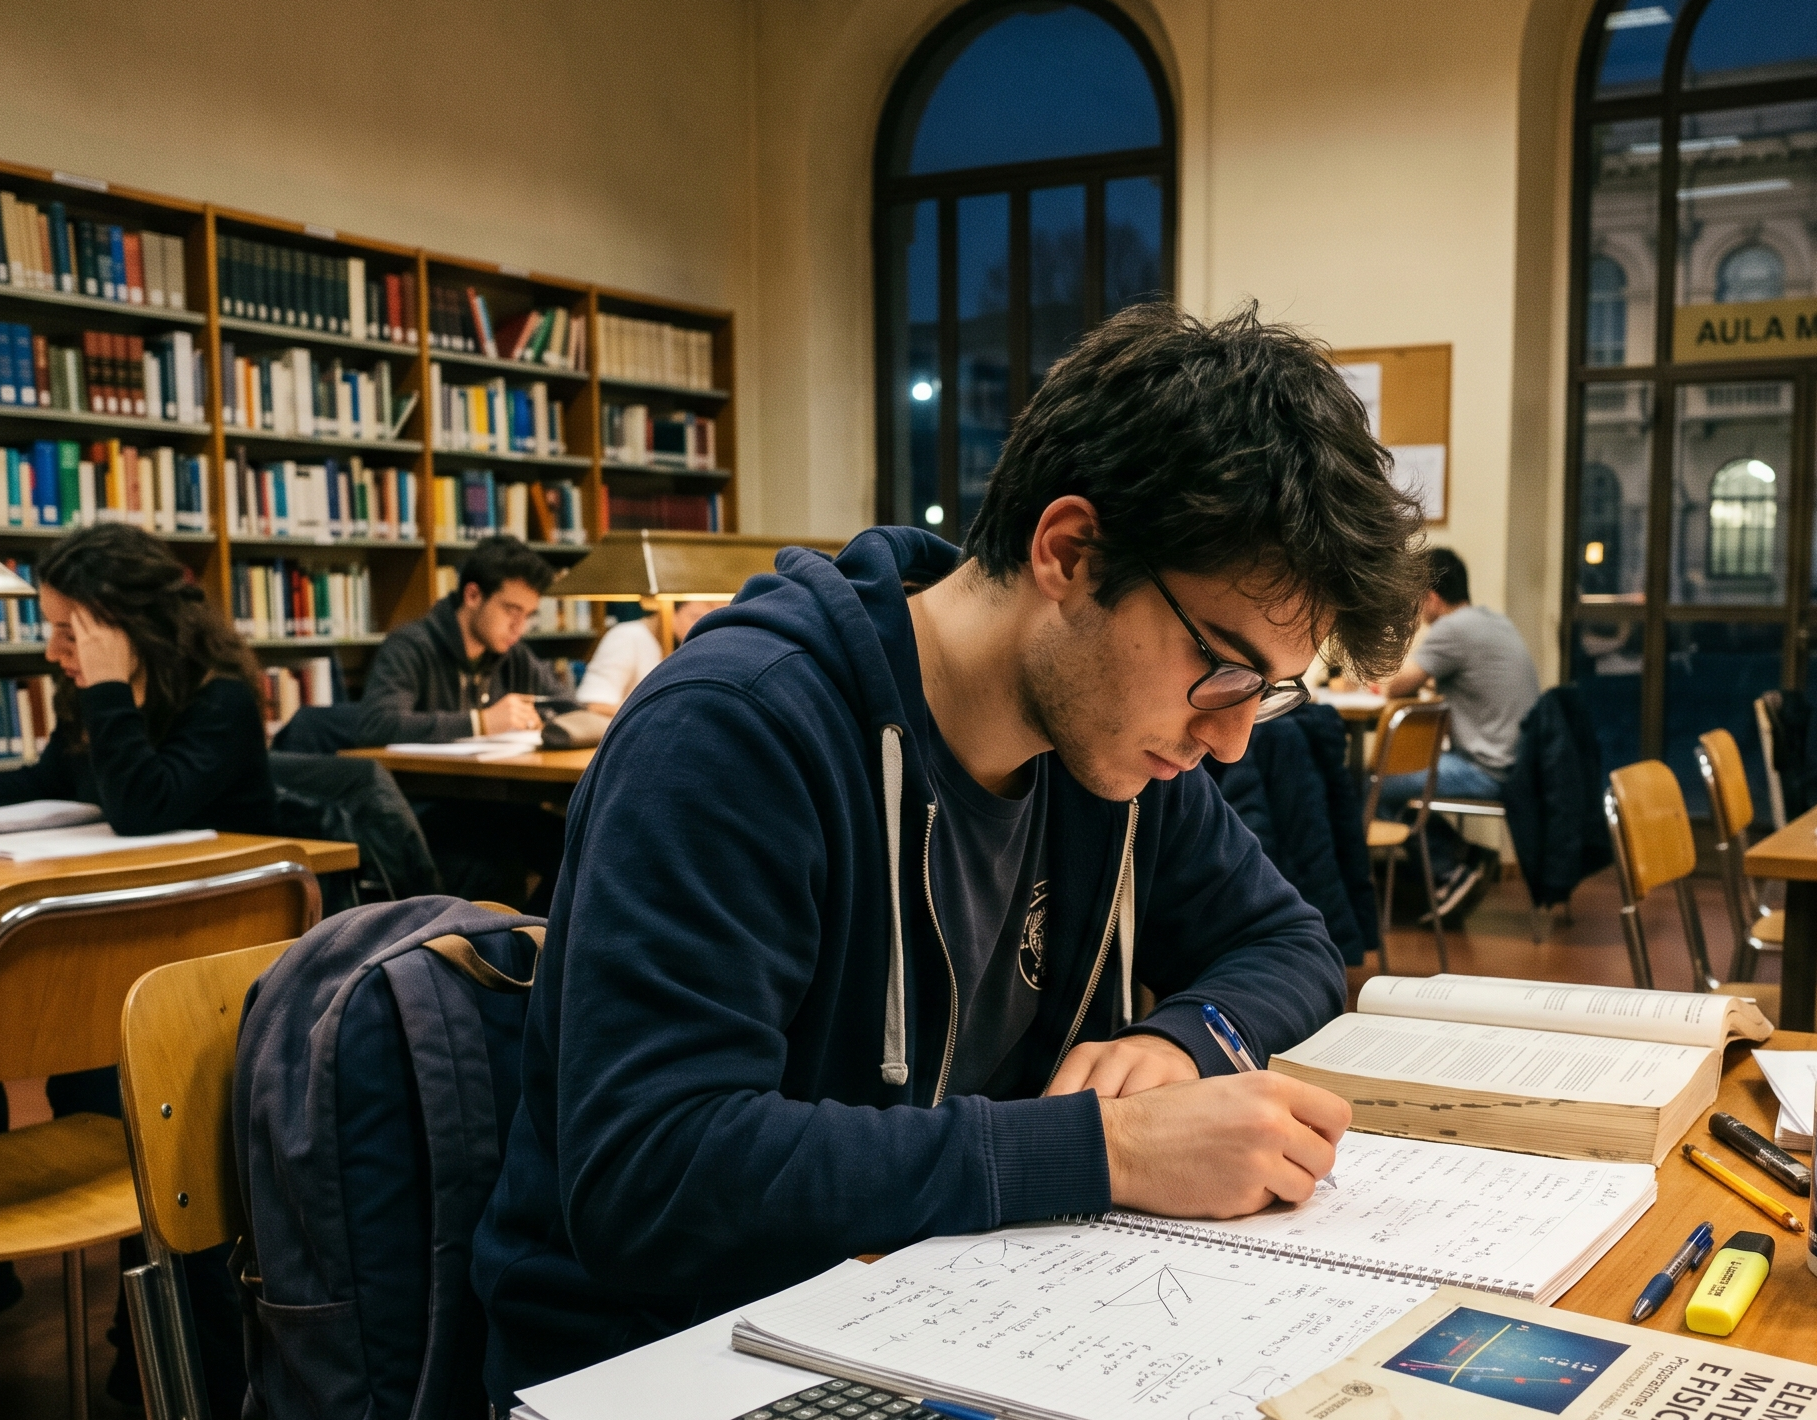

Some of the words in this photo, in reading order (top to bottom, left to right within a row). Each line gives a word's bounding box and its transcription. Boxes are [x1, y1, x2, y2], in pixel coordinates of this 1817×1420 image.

[1697, 316, 1784, 345] AULA
[1797, 314, 1817, 338] M
[1696, 1362, 1733, 1378] E
[1650, 1376, 1721, 1420] FISIC
[1703, 1371, 1775, 1420] MATE
